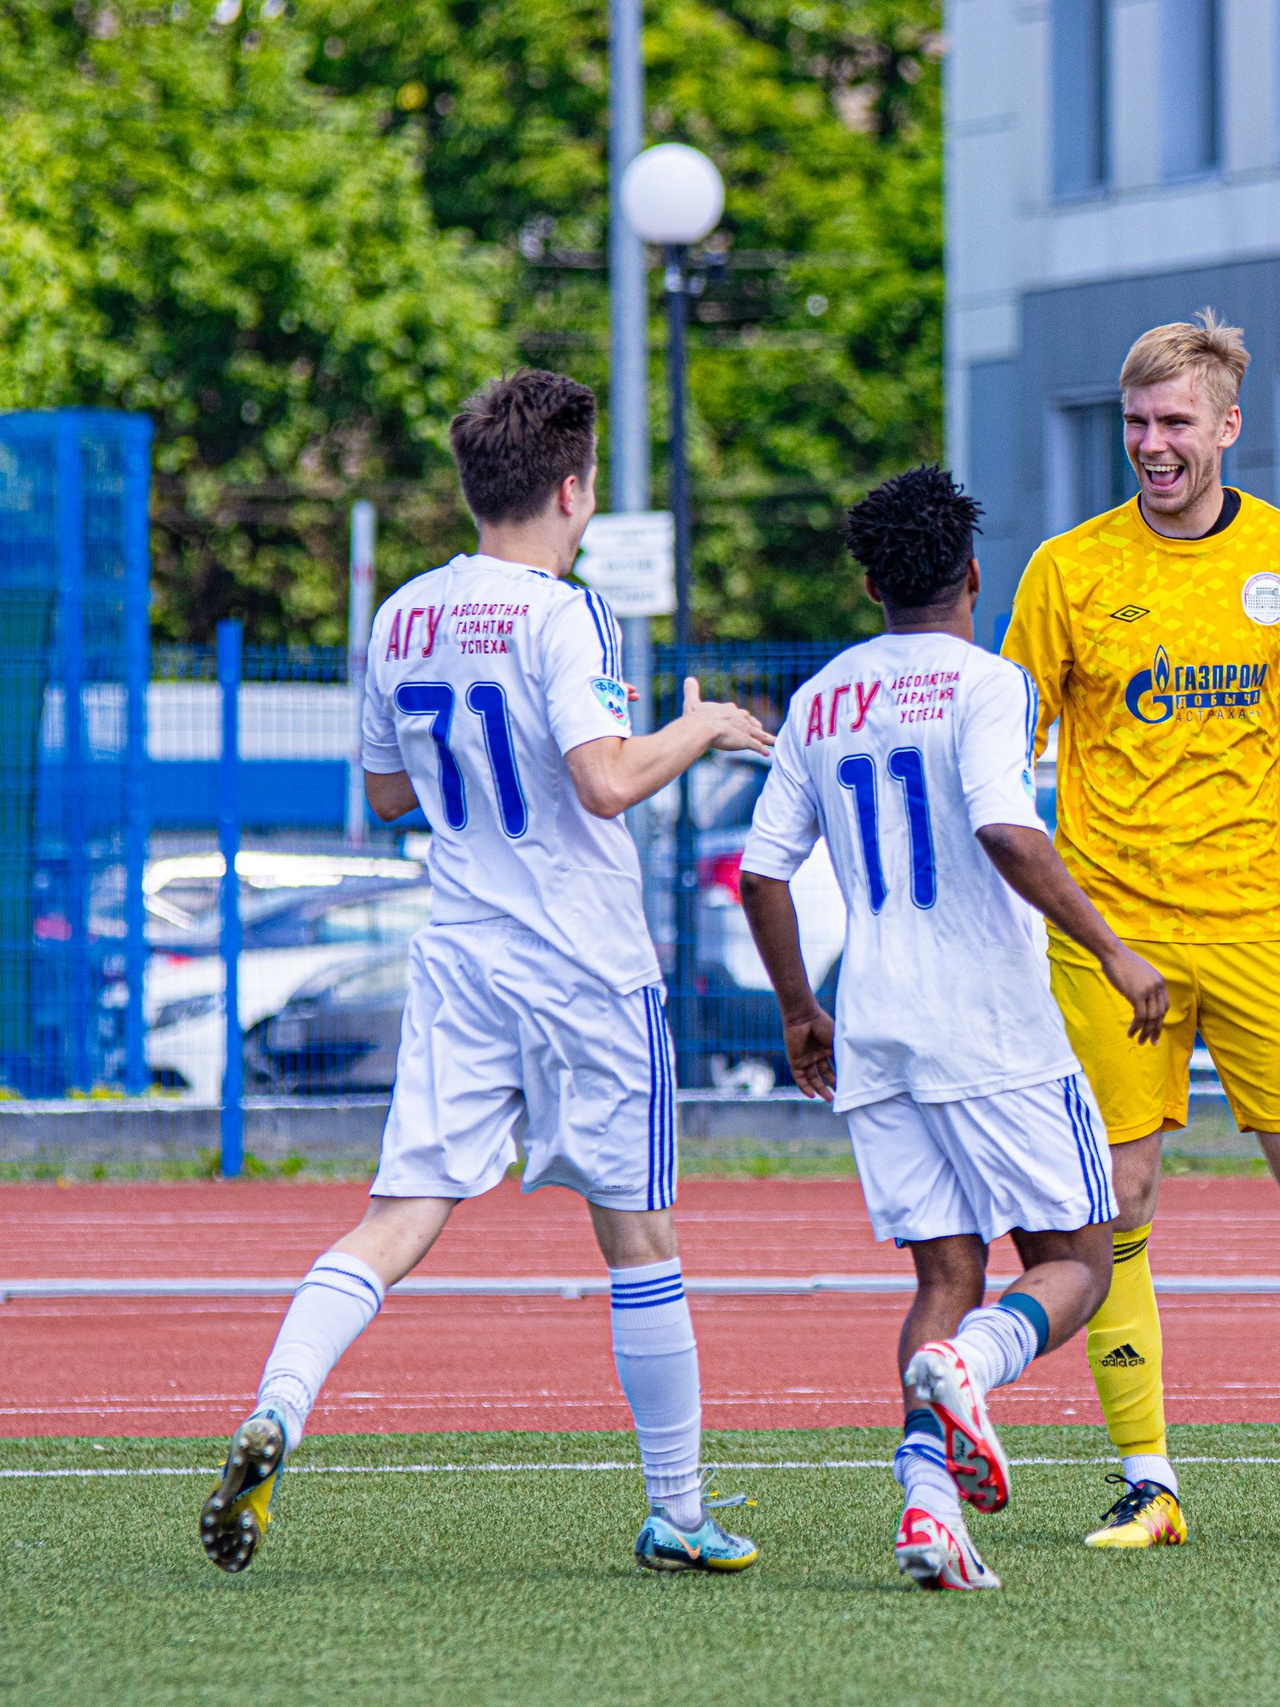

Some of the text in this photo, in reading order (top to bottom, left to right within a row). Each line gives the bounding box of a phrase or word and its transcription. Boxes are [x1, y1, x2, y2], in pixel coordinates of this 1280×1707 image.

[451, 602, 529, 617] АБСОЛЮТНАЯ
[385, 604, 446, 662] АГУ
[455, 619, 514, 635] ГАРАНТИЯ
[461, 639, 508, 655] УСПЕХА
[1174, 663, 1268, 692] ГАЗПРОМ
[1177, 690, 1260, 710] ДОБЫЧА
[804, 680, 882, 747] АГУ
[394, 681, 528, 839] 71
[837, 746, 937, 916] 11
[1101, 1357, 1146, 1368] adidas
